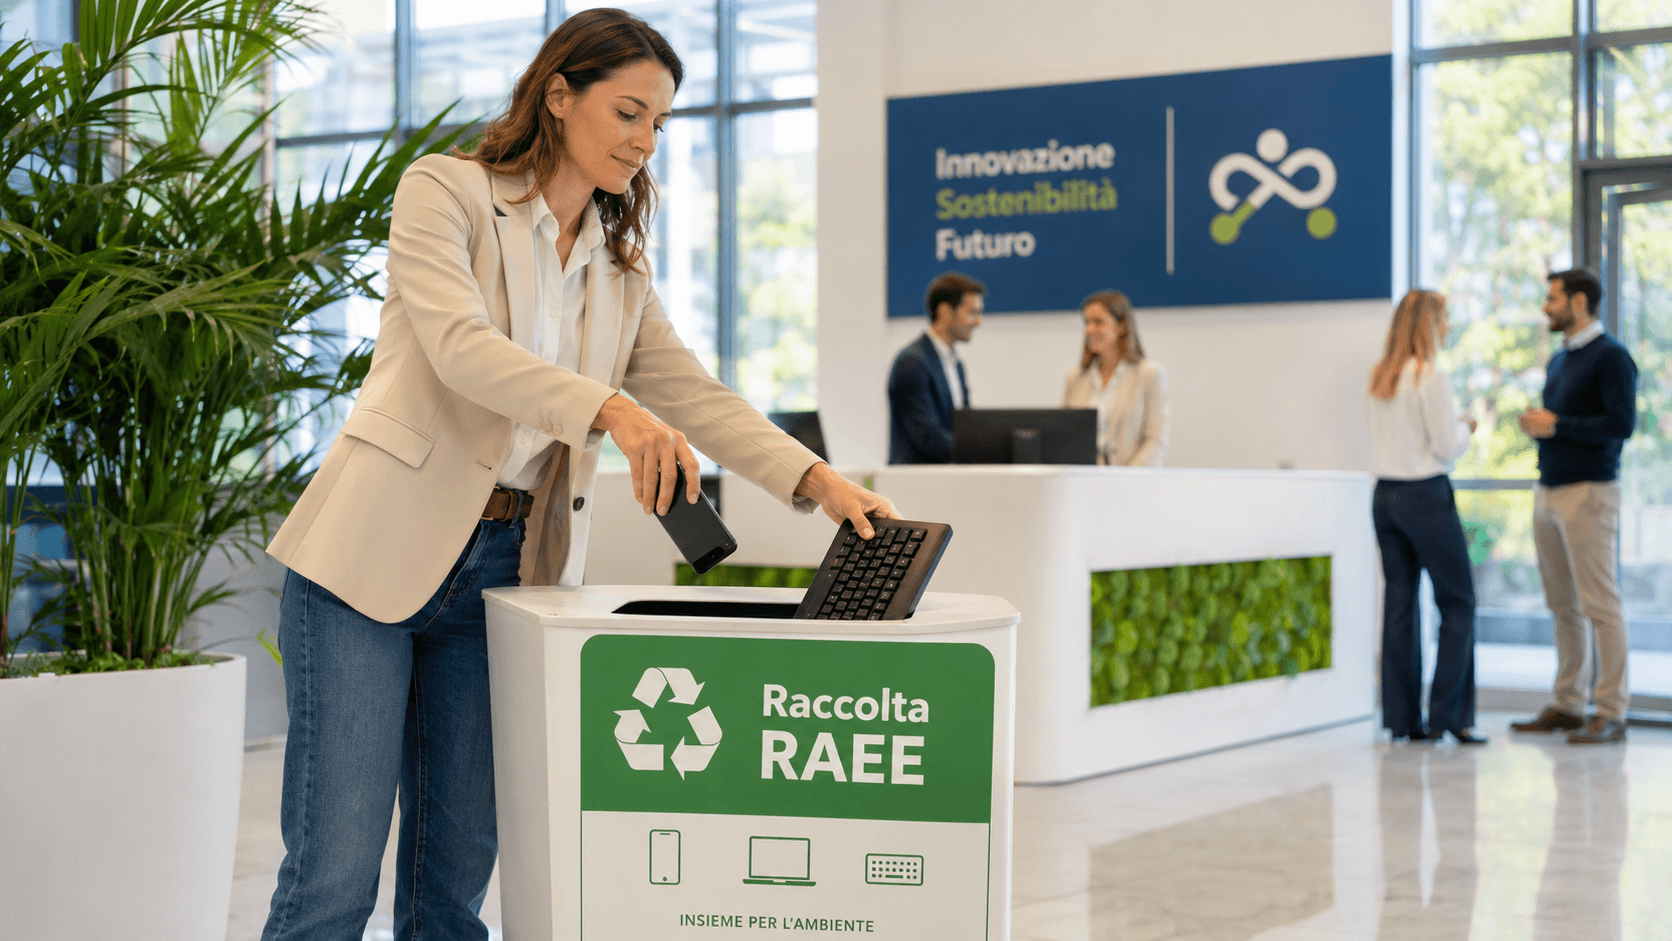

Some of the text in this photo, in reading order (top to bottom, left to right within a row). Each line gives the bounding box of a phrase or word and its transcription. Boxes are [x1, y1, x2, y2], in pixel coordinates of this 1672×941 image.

[936, 139, 1115, 179] Innovazione
[936, 178, 1117, 220] Sostenibilità
[936, 229, 1036, 261] Futuro
[763, 684, 930, 723] Raccolta
[761, 729, 925, 786] RAEE
[680, 914, 874, 932] INSIEME PER L'AMBIENTE
